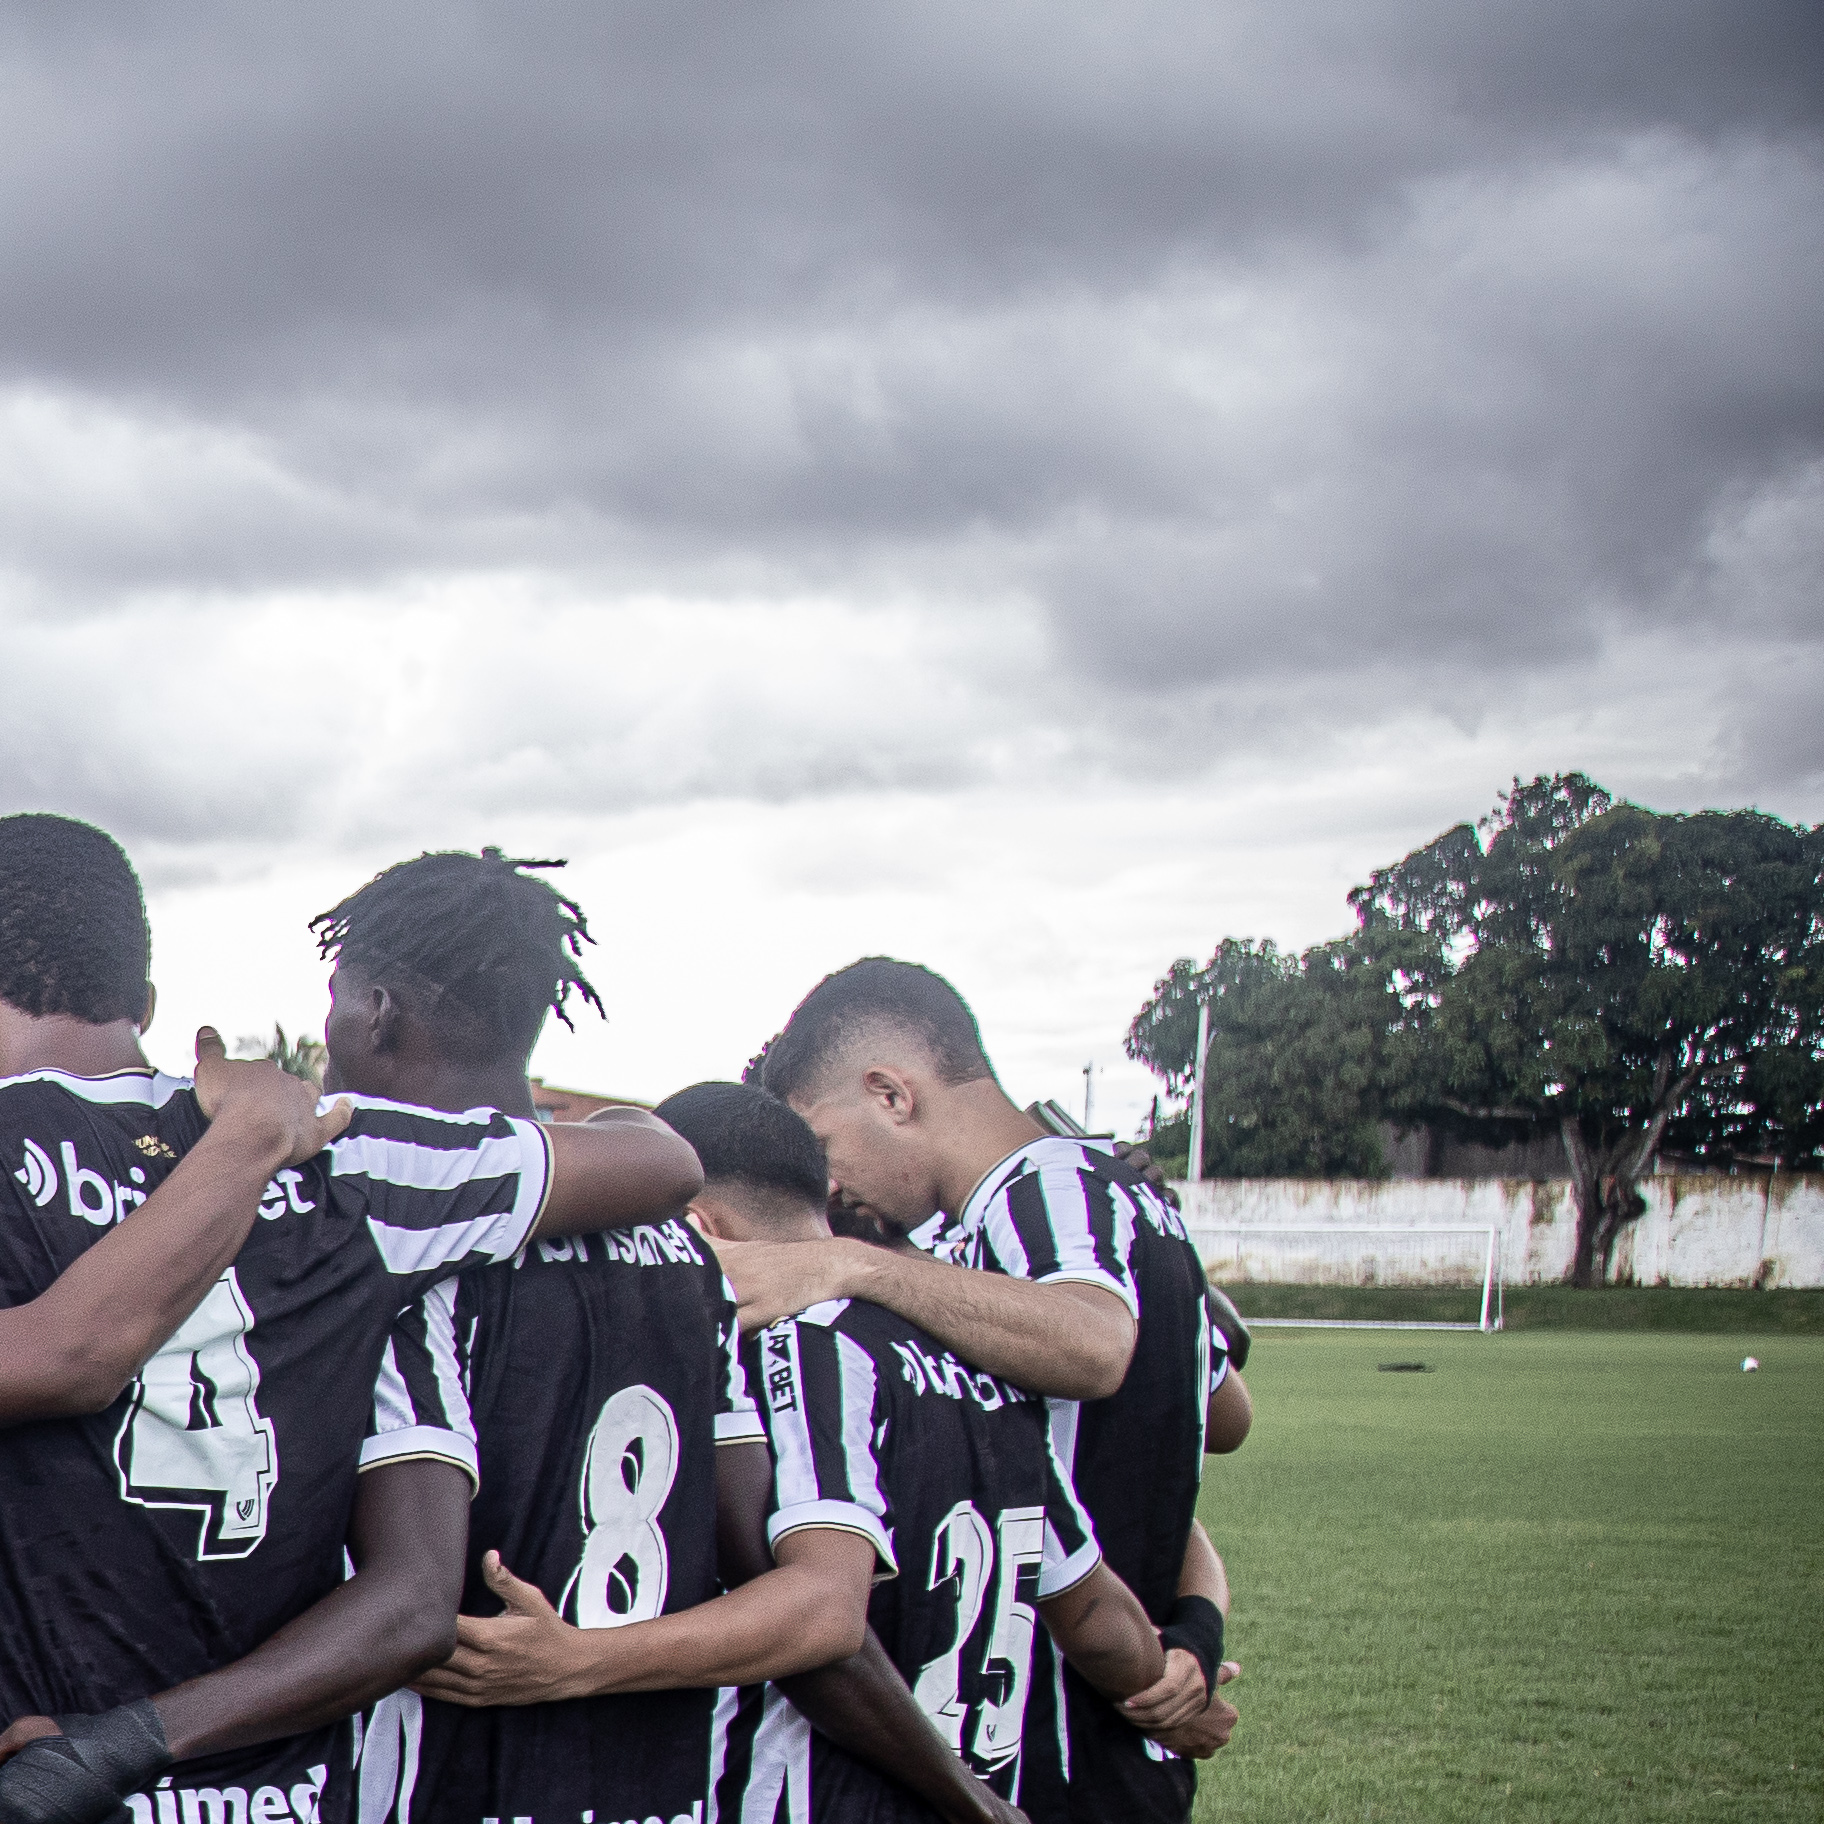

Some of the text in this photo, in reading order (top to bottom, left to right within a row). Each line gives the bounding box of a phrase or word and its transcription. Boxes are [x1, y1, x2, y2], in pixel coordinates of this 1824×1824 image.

[61, 1141, 315, 1226] briet
[114, 1267, 278, 1561] 4
[556, 1384, 680, 1629] 8
[912, 1499, 1044, 1780] 25
